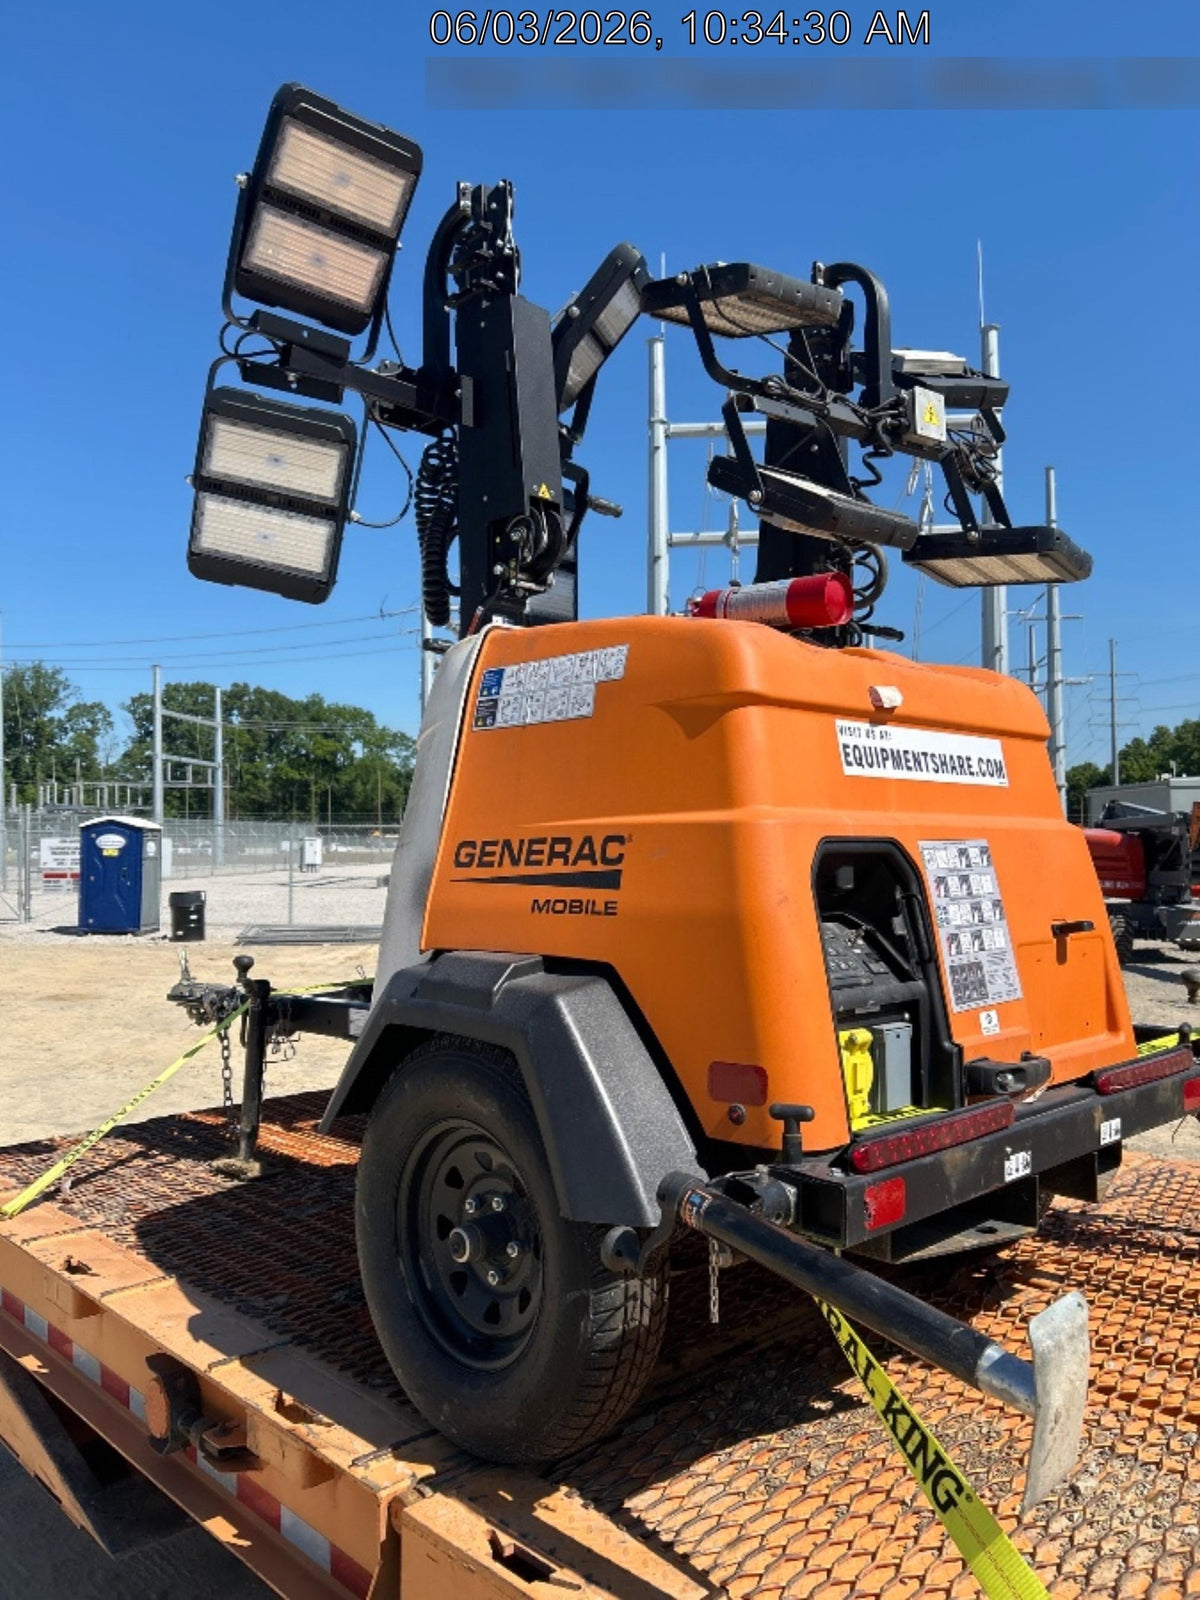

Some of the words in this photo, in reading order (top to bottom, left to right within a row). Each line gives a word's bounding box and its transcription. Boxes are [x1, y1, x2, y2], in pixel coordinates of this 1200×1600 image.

[841, 742, 1006, 779] EQUIPMENTSHARE.COM
[453, 835, 626, 868] GENERAC
[531, 899, 618, 916] MOBILE
[881, 1388, 965, 1514] KING
